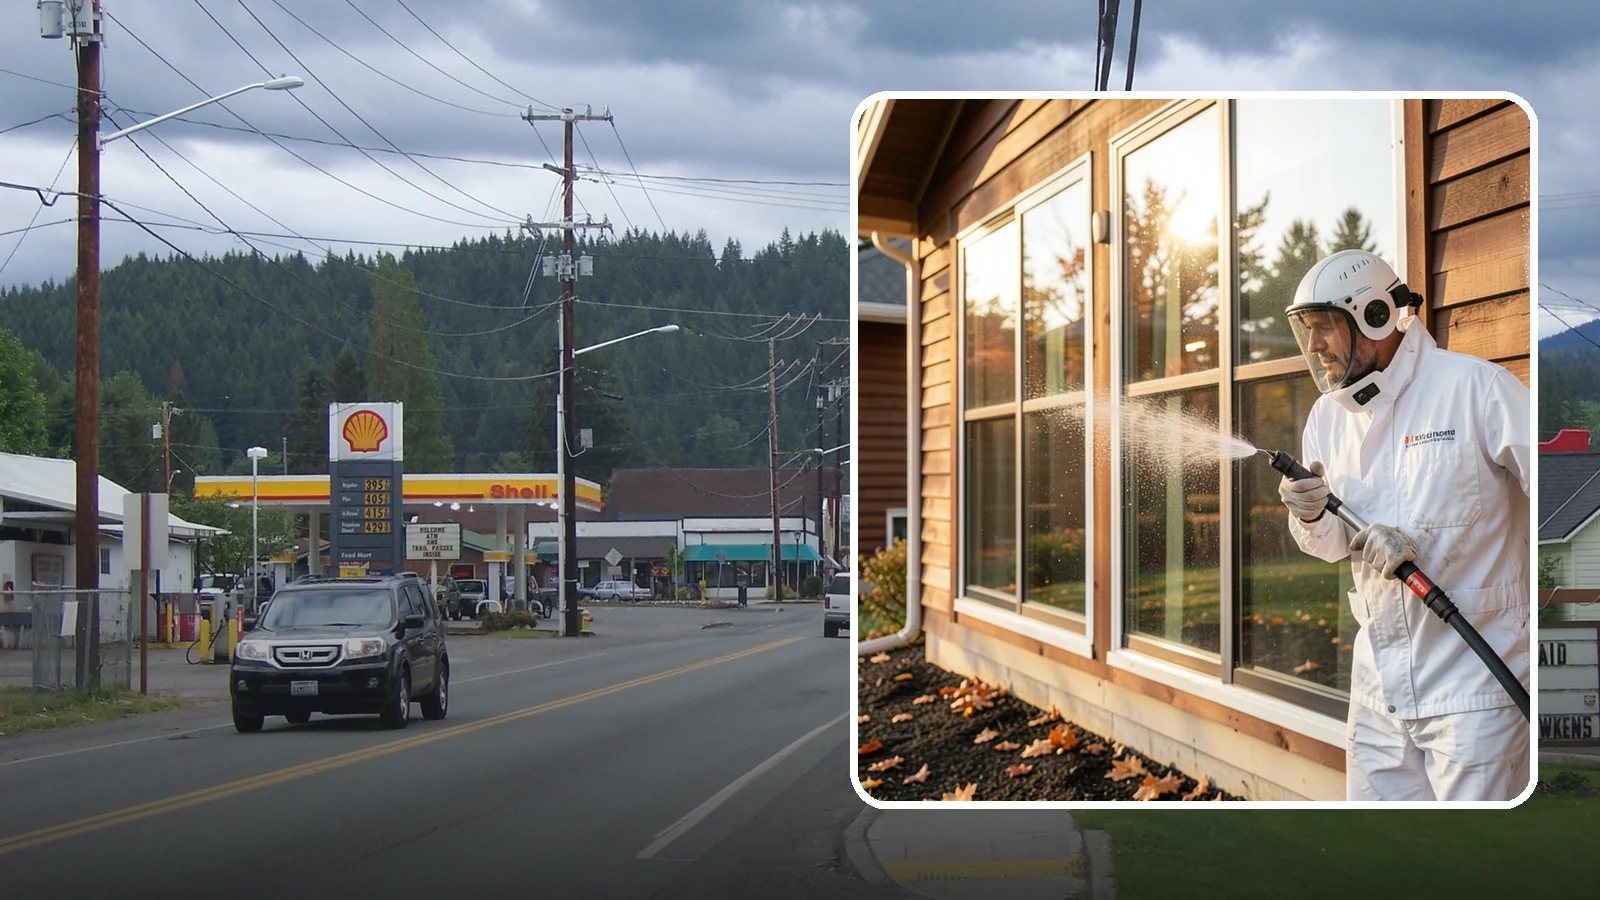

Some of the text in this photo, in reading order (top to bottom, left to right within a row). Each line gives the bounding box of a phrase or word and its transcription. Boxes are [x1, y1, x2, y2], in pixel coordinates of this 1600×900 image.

[366, 480, 383, 490] 395
[490, 484, 547, 498] Shell
[366, 494, 383, 504] 405
[366, 508, 383, 518] 415
[366, 522, 383, 532] 429
